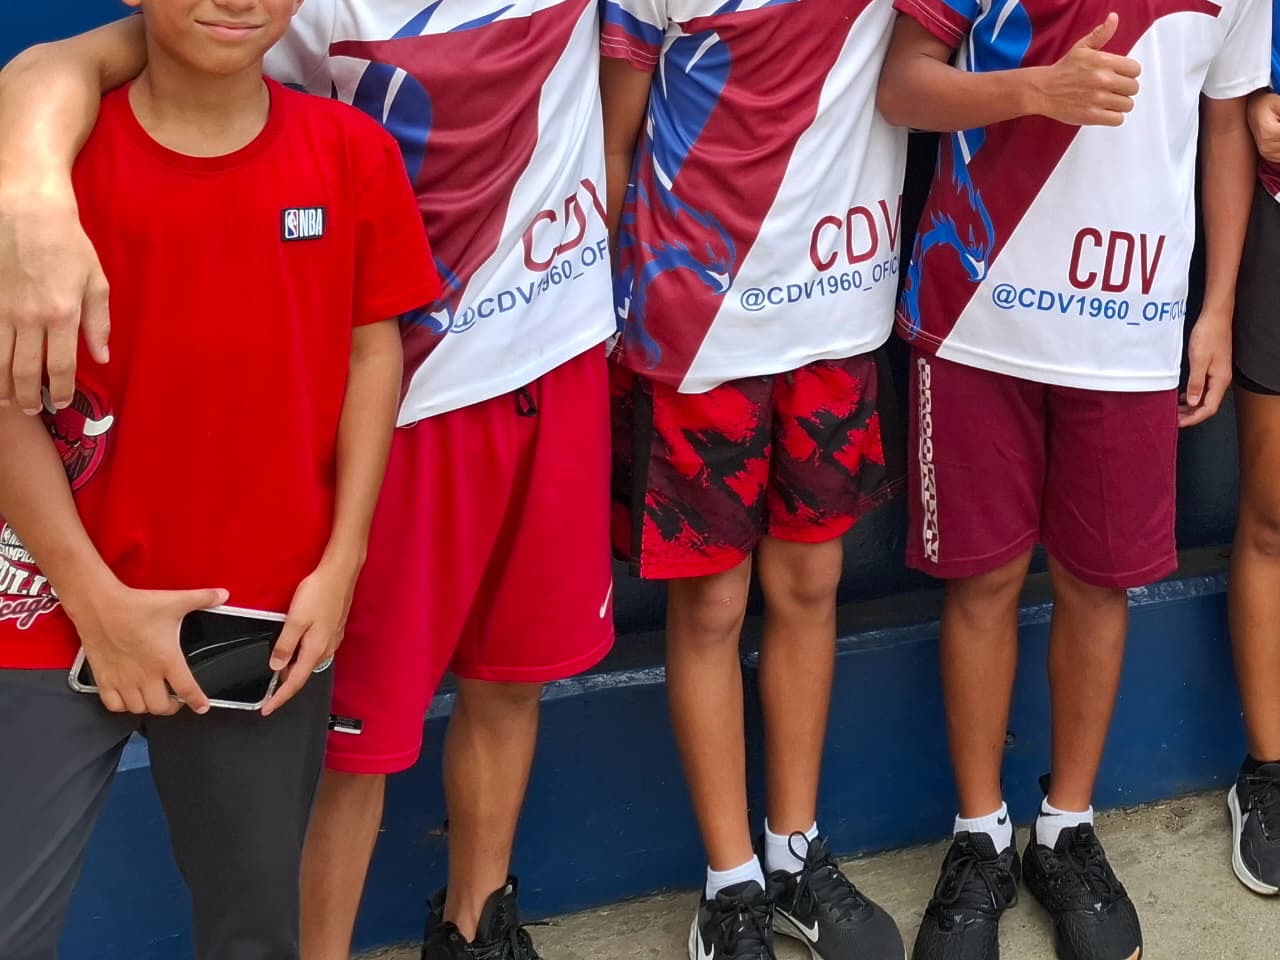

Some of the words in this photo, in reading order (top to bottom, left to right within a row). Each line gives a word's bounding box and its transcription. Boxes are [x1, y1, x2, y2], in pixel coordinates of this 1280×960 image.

[299, 208, 323, 237] NBA
[809, 194, 902, 272] CDV
[1068, 227, 1166, 295] CDV
